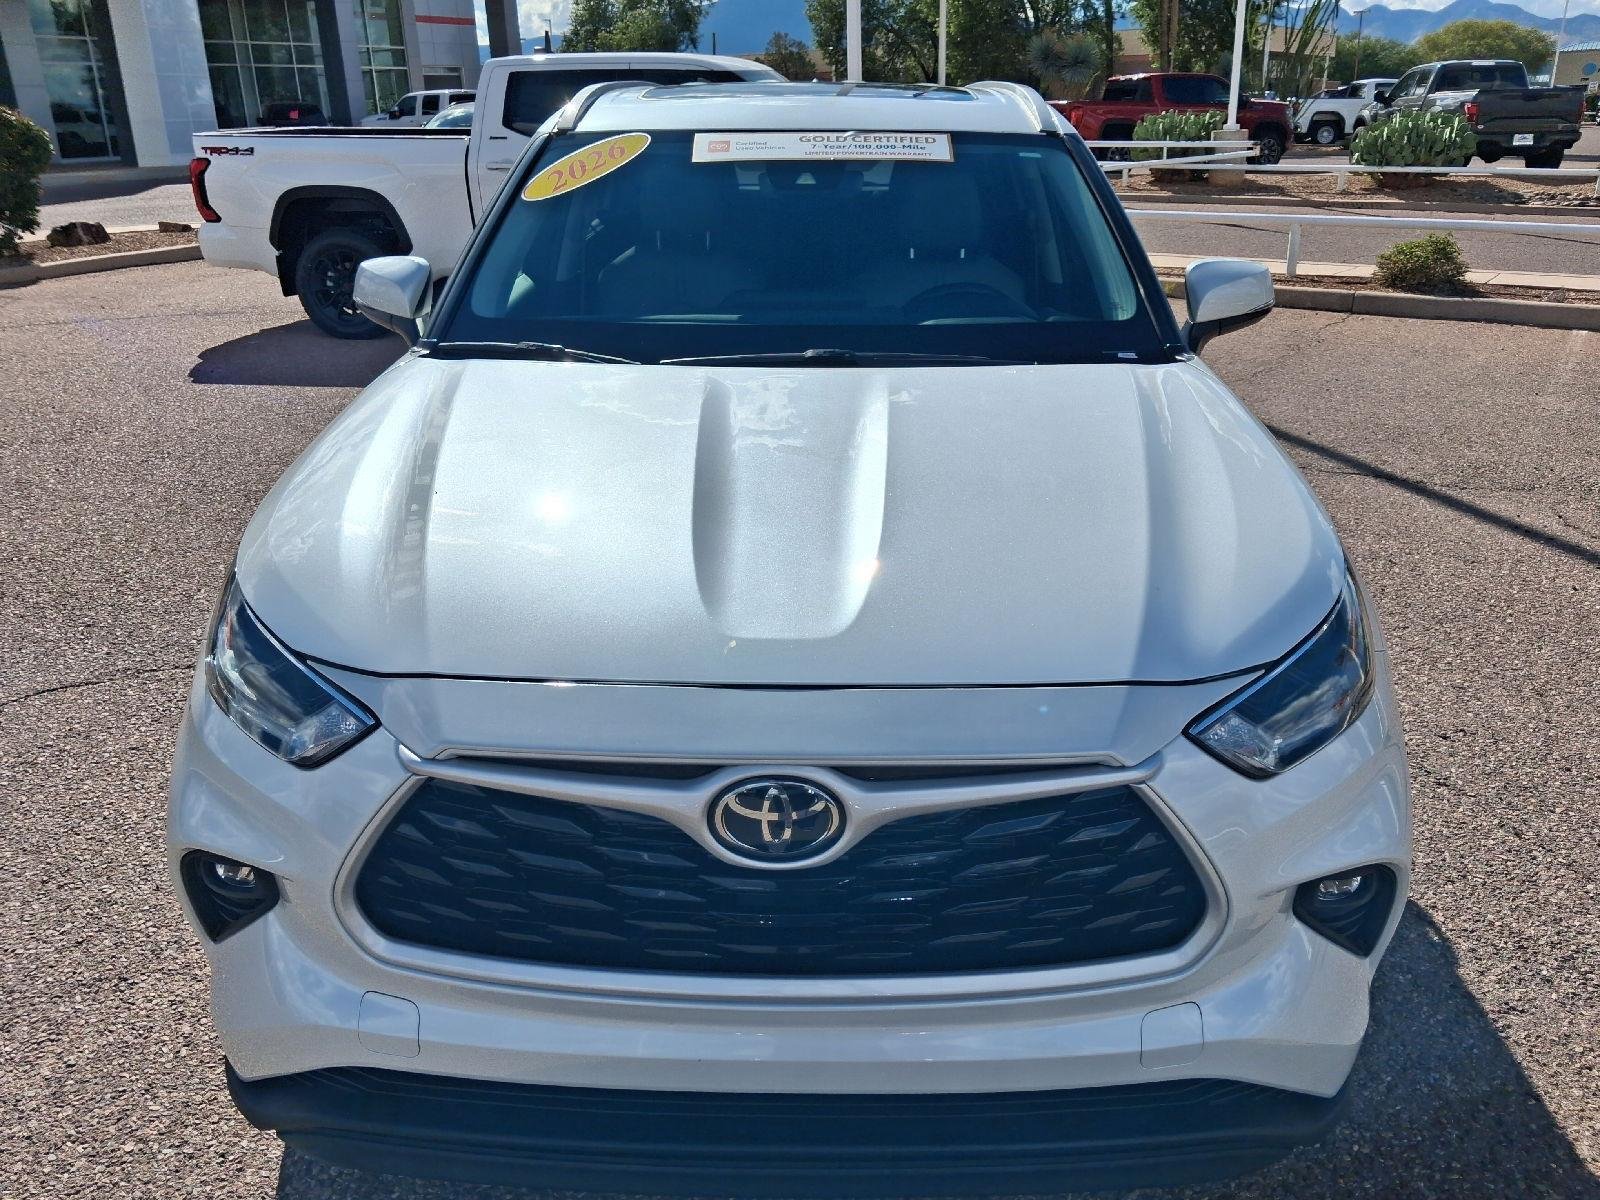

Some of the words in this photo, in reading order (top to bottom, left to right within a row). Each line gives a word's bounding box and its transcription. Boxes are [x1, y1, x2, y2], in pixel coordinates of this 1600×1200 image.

[799, 135, 848, 143] GOLD
[850, 135, 937, 144] CERTIFIED
[548, 143, 626, 193] 2026
